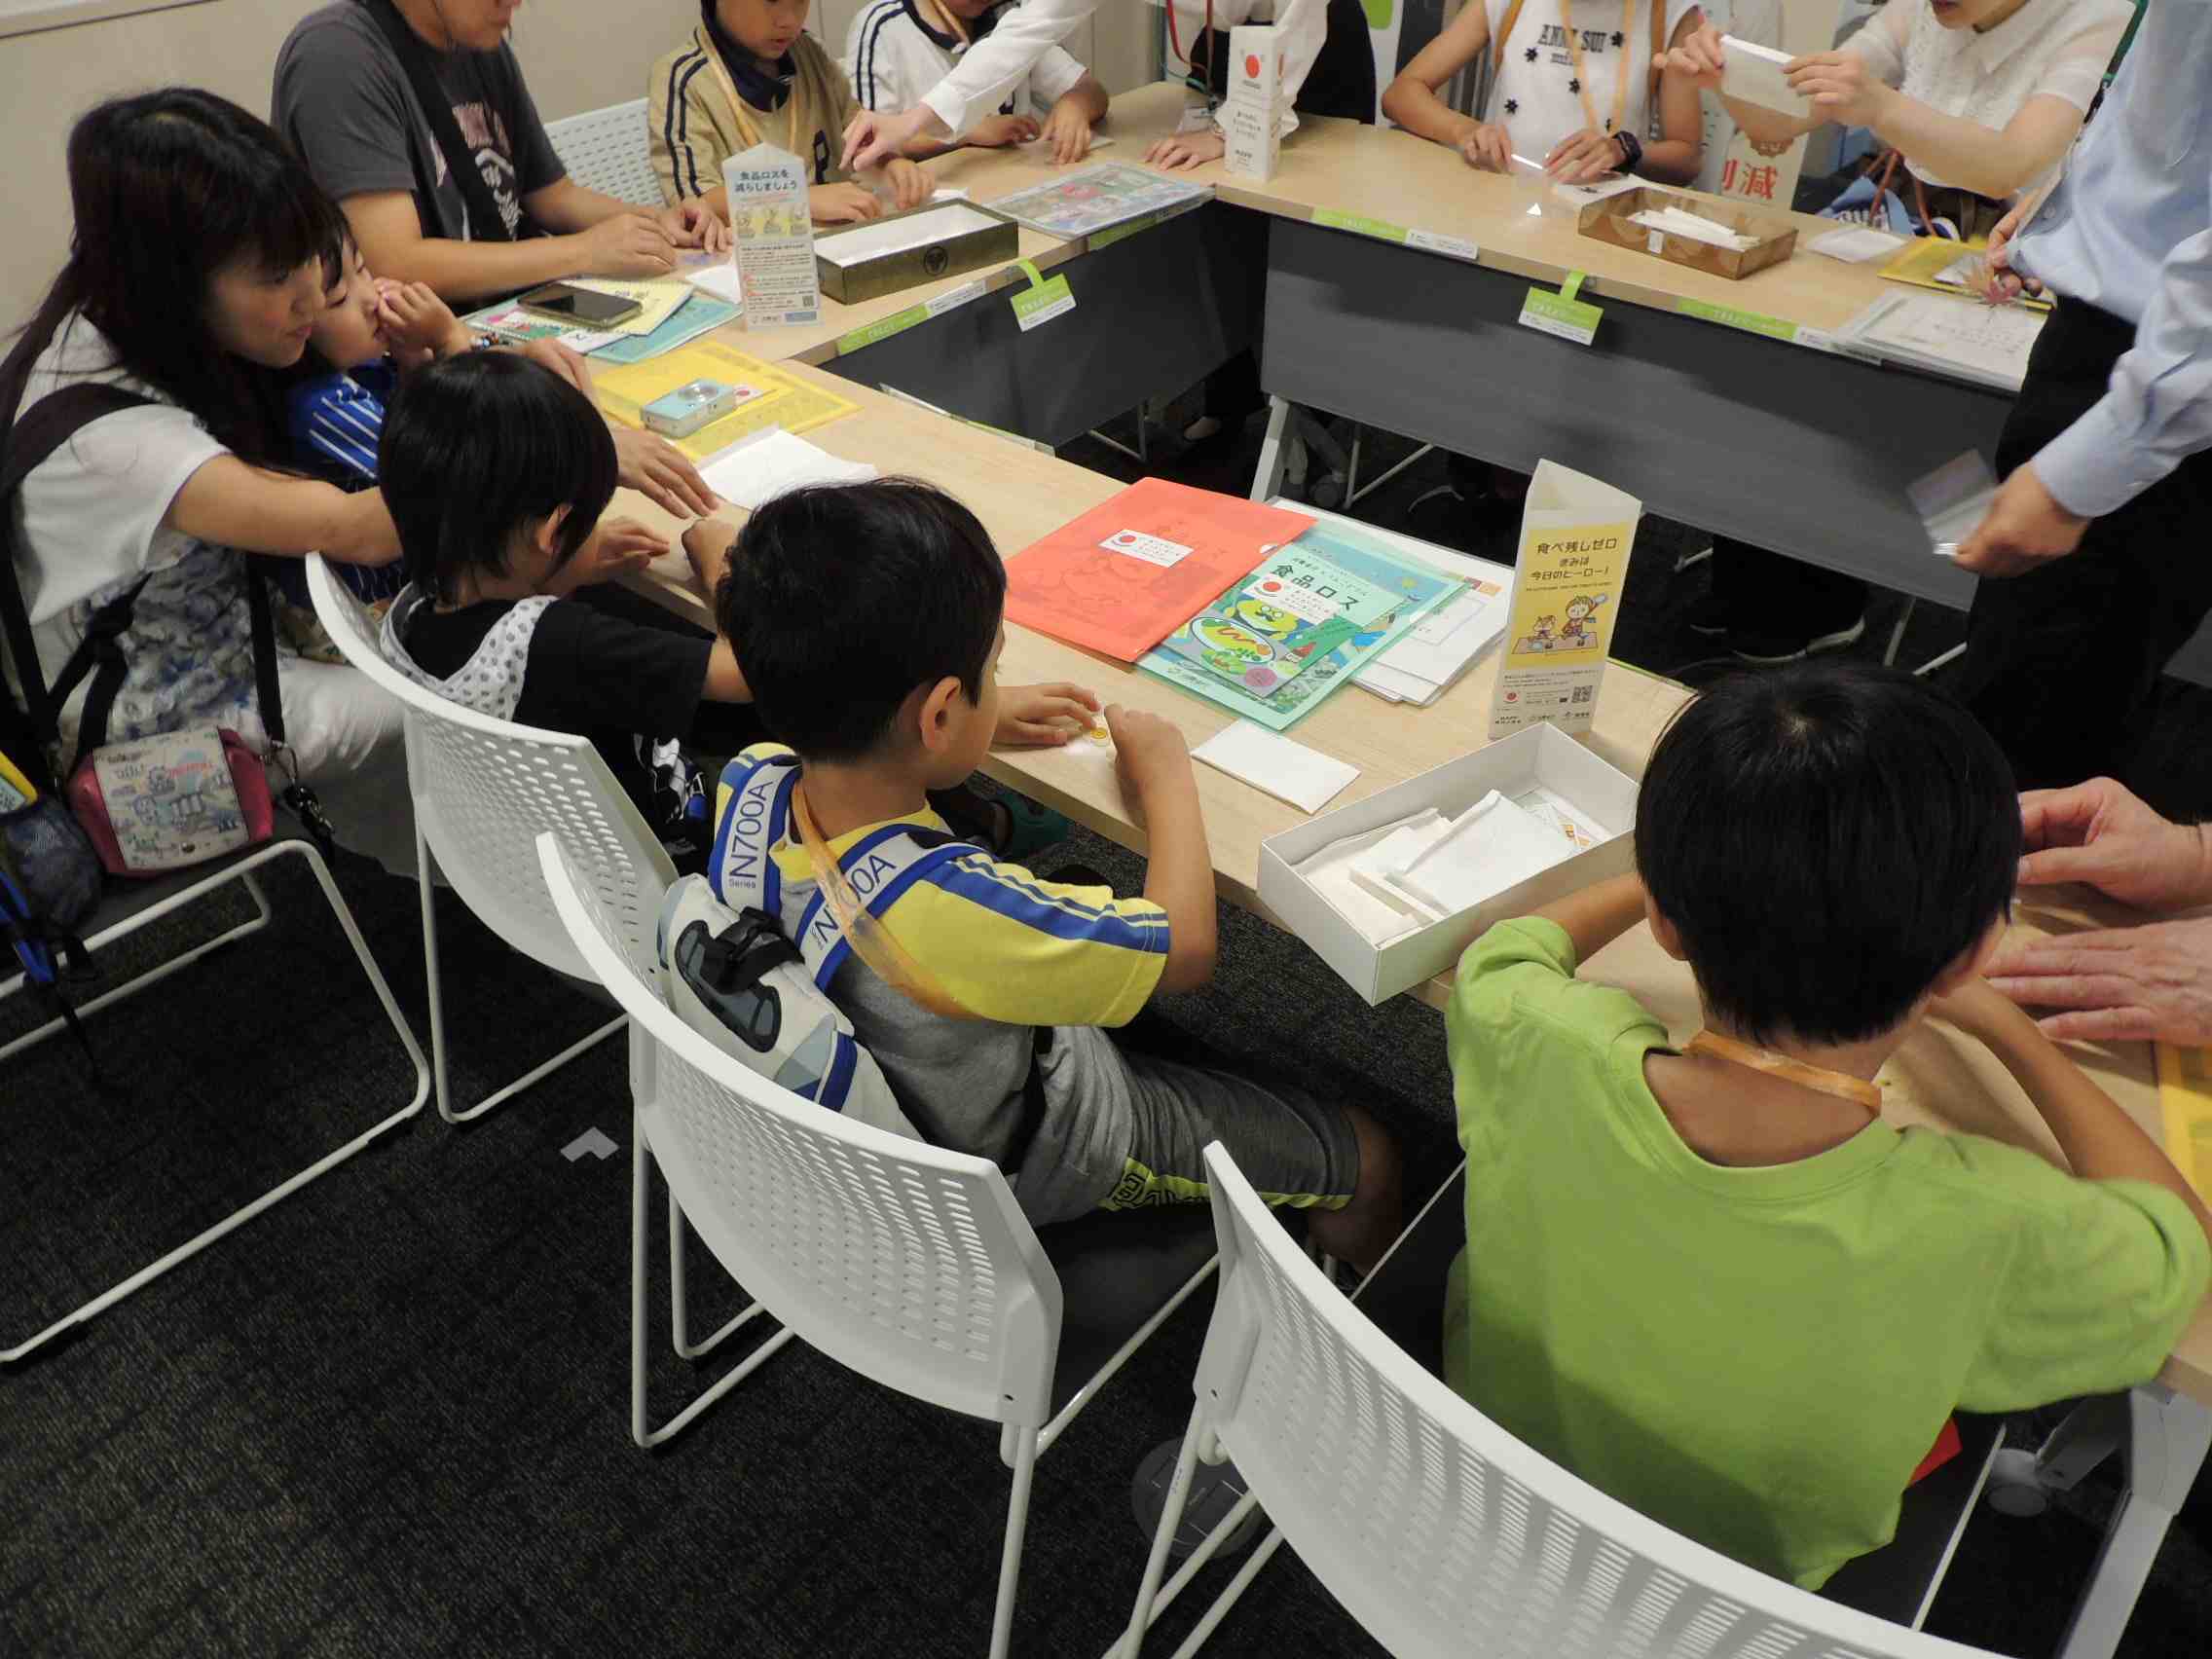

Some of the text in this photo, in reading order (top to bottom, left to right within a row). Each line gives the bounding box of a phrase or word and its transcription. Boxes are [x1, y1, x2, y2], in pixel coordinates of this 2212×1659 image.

[740, 169, 790, 182] 食品ロスを
[735, 181, 797, 193] 減らしましょう
[1536, 537, 1620, 555] 食べ残しゼロ
[1559, 556, 1590, 568] きみは
[1270, 565, 1360, 611] 食品ロス
[728, 780, 774, 879] N700A
